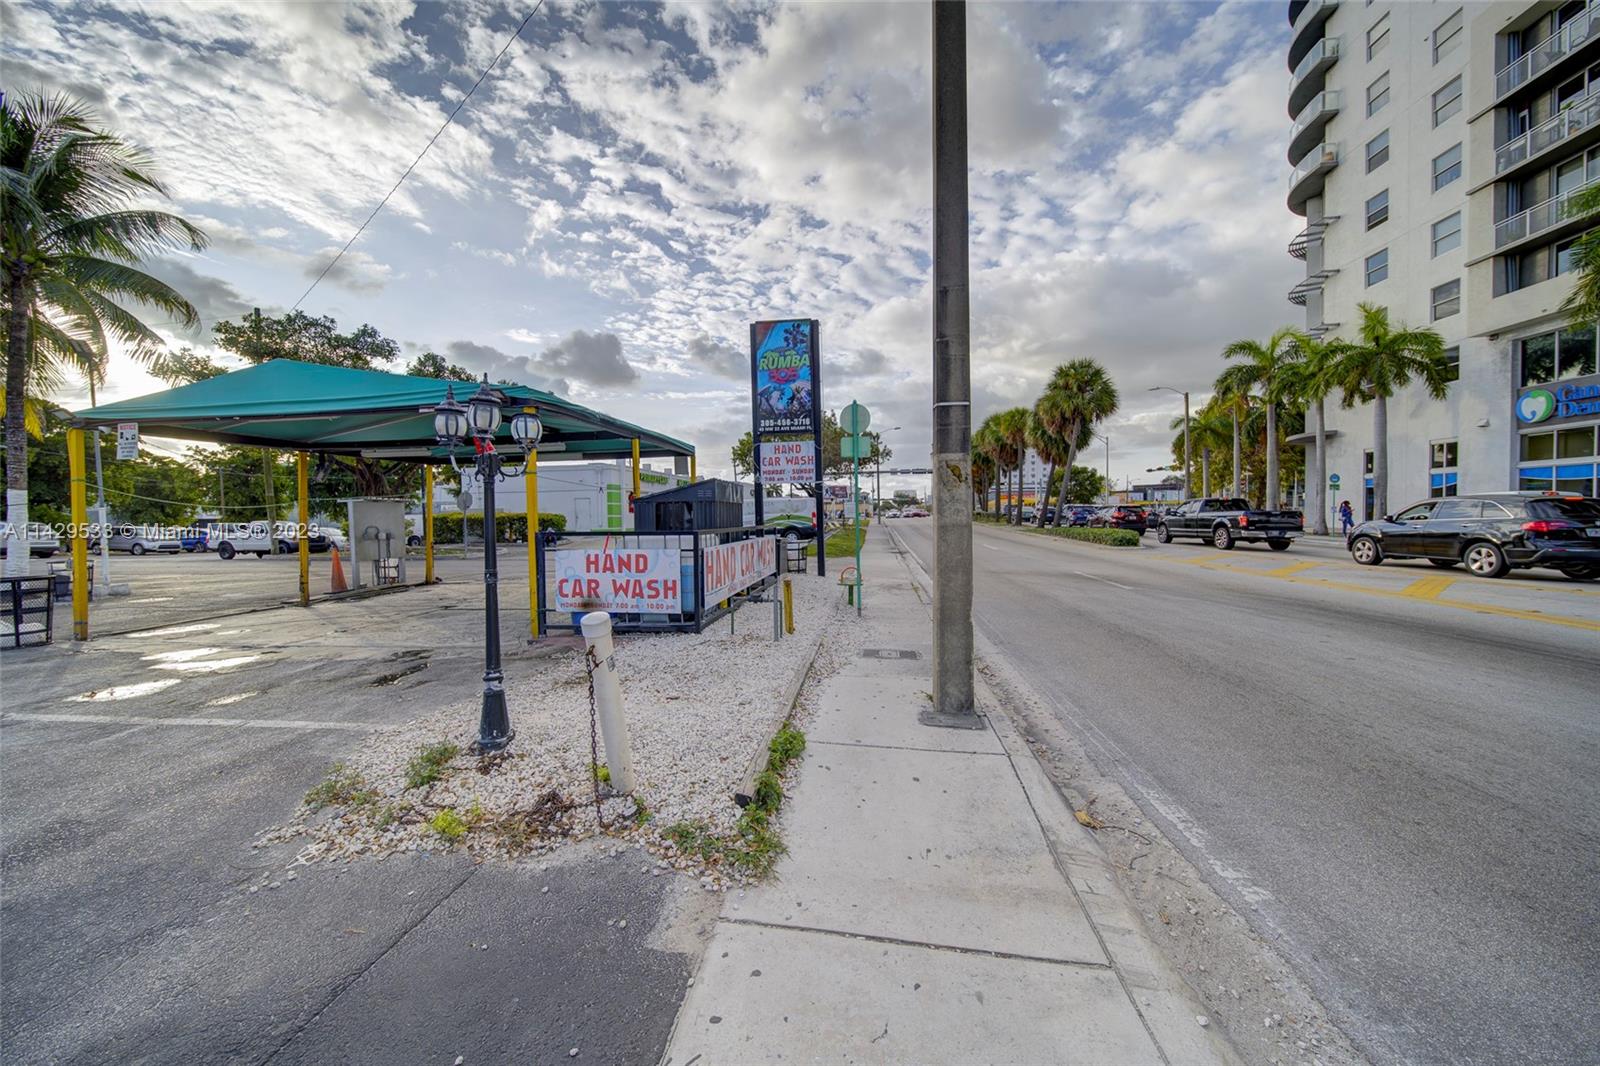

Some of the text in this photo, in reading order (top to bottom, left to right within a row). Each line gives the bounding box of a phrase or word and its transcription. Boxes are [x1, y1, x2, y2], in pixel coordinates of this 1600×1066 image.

[759, 353, 810, 370] RUMBA
[774, 445, 801, 454] HAND
[762, 456, 814, 467] CAR WASH
[586, 553, 648, 573] HAND
[705, 542, 736, 592] HAND
[558, 578, 677, 599] CAR WASH
